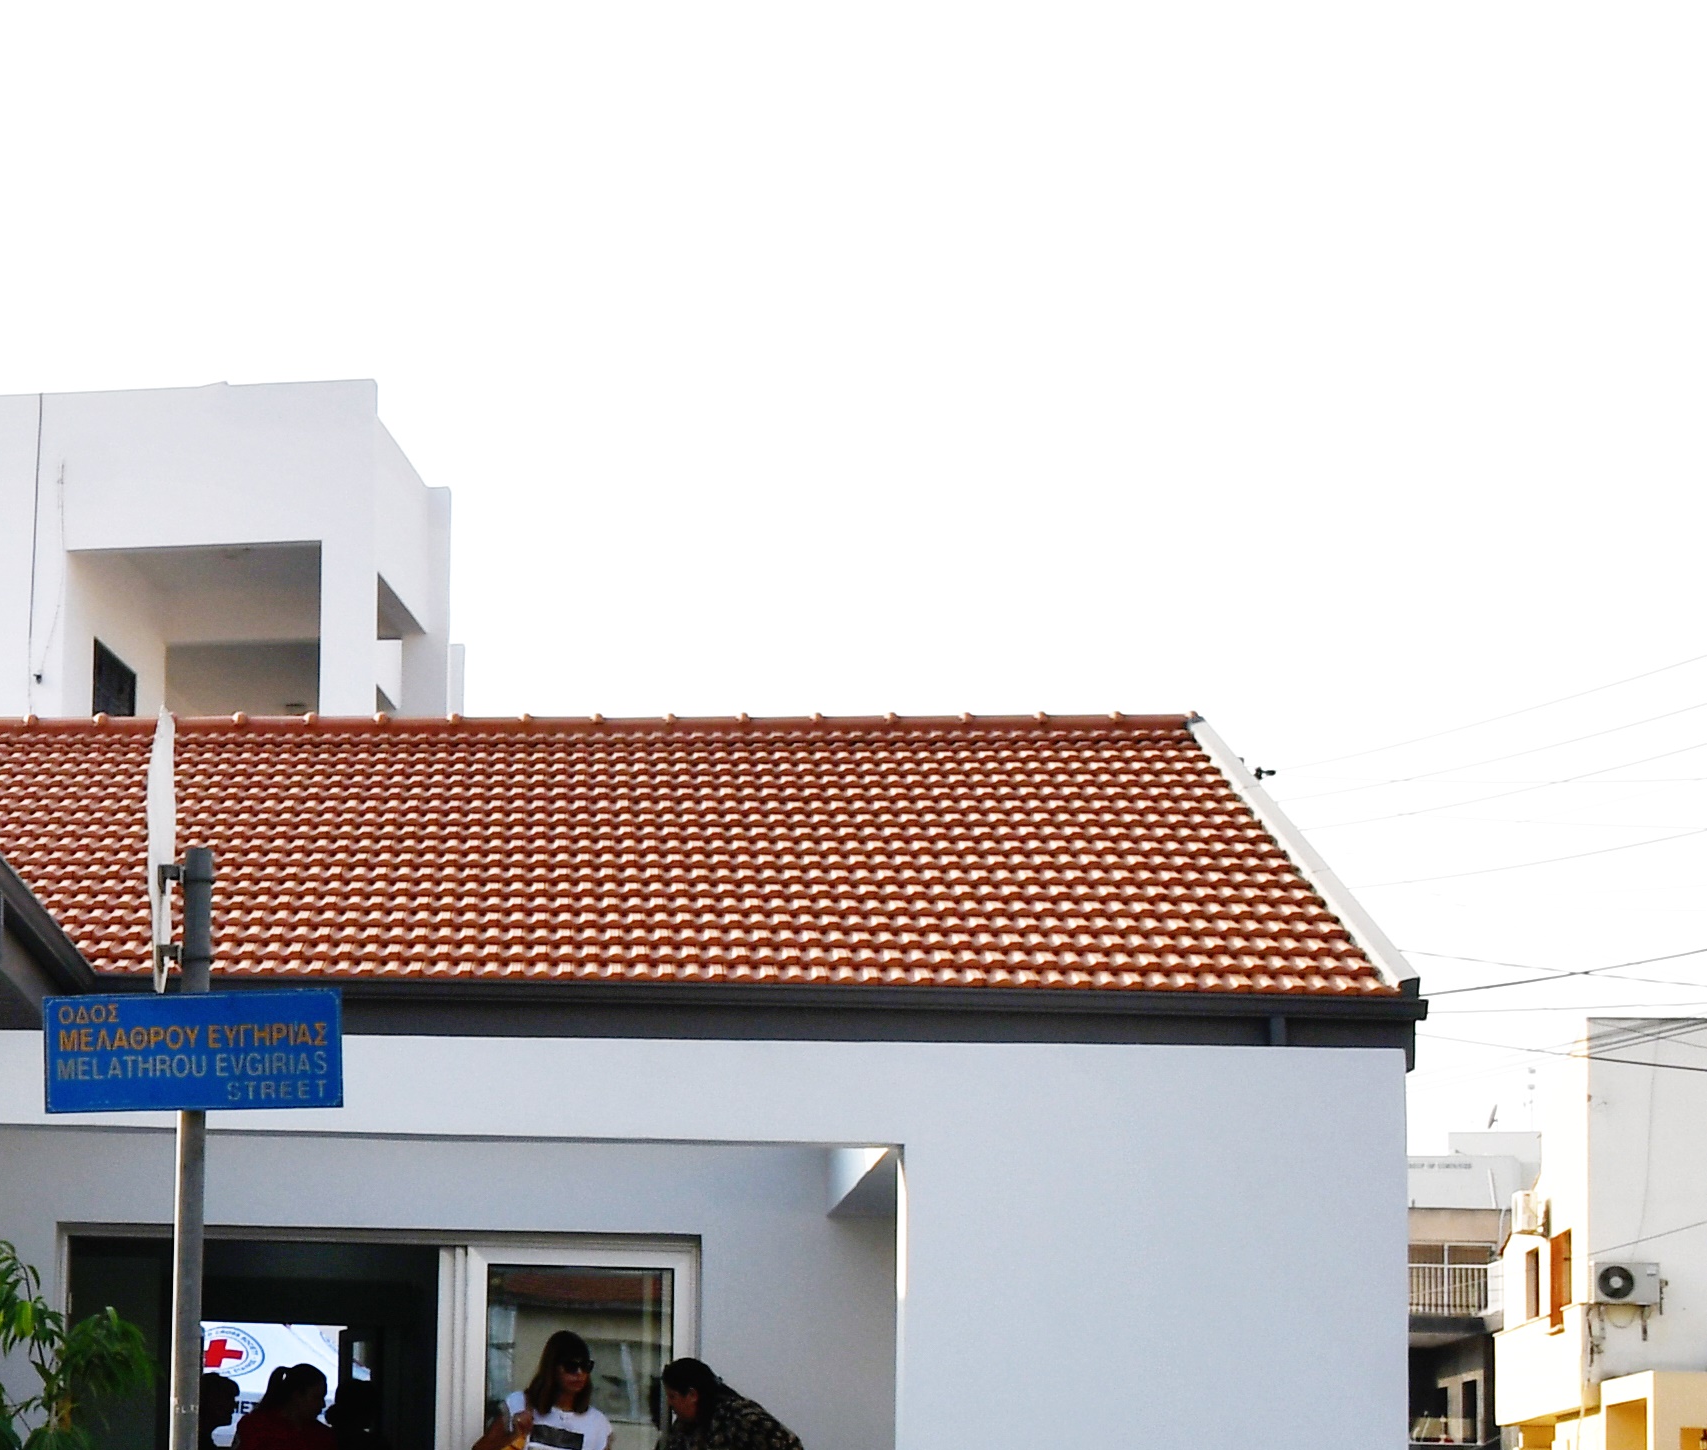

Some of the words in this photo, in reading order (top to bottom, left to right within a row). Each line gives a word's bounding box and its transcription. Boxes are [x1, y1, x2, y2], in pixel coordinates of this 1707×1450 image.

[59, 1003, 118, 1024] ΟΔΟΣ
[60, 1026, 197, 1051] ΜΕΛΑΘΡΟΥ
[208, 1022, 327, 1048] ΕΥΓΗΡΙΑΣ
[57, 1056, 206, 1080] MELATHROU
[216, 1051, 327, 1076] EVGIRIAS
[228, 1080, 327, 1100] STREET
